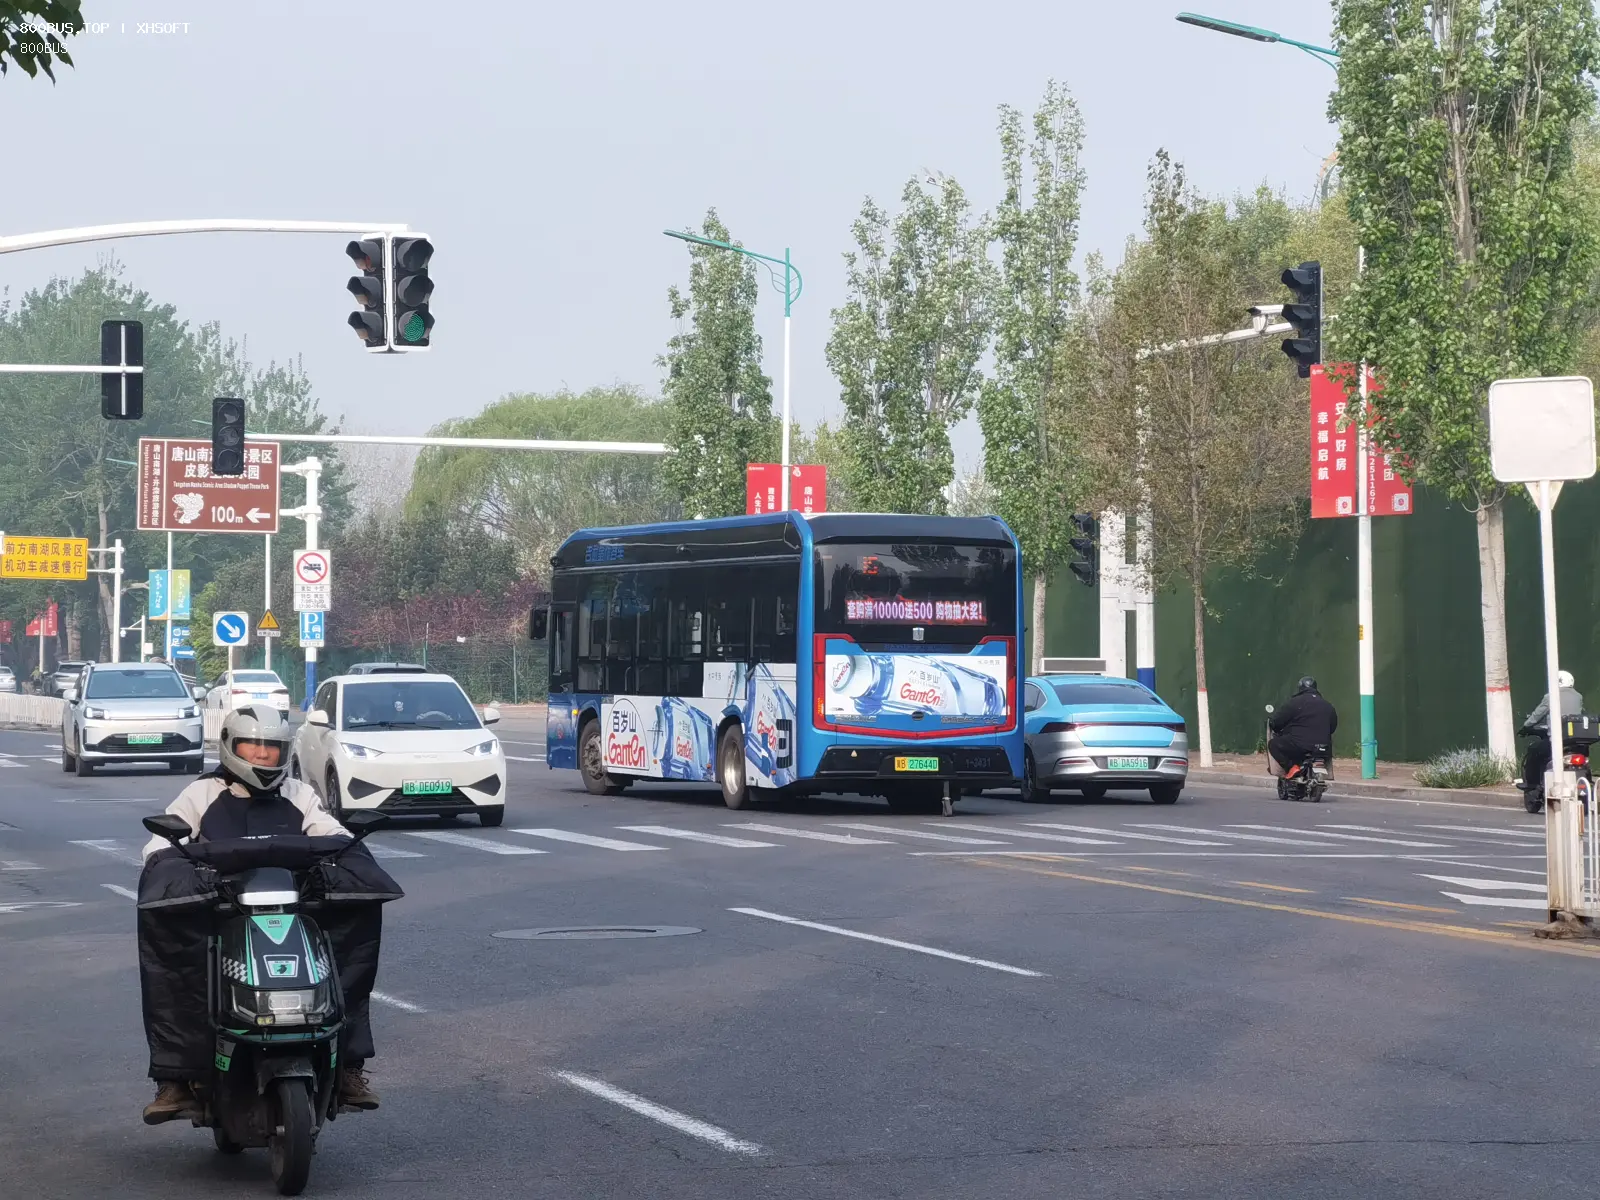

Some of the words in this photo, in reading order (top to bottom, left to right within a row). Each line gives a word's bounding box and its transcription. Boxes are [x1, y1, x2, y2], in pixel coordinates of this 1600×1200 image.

[1318, 412, 1329, 480] 幸福启航
[172, 446, 272, 464] 唐山南景区
[211, 506, 243, 523] 100m
[6, 542, 82, 556] 前方南湖风景区
[5, 559, 82, 574] 机动车减速慢行
[302, 612, 319, 633] P
[613, 710, 636, 733] 百岁山
[1121, 758, 1147, 767] DA5916
[420, 780, 450, 792] DE0919
